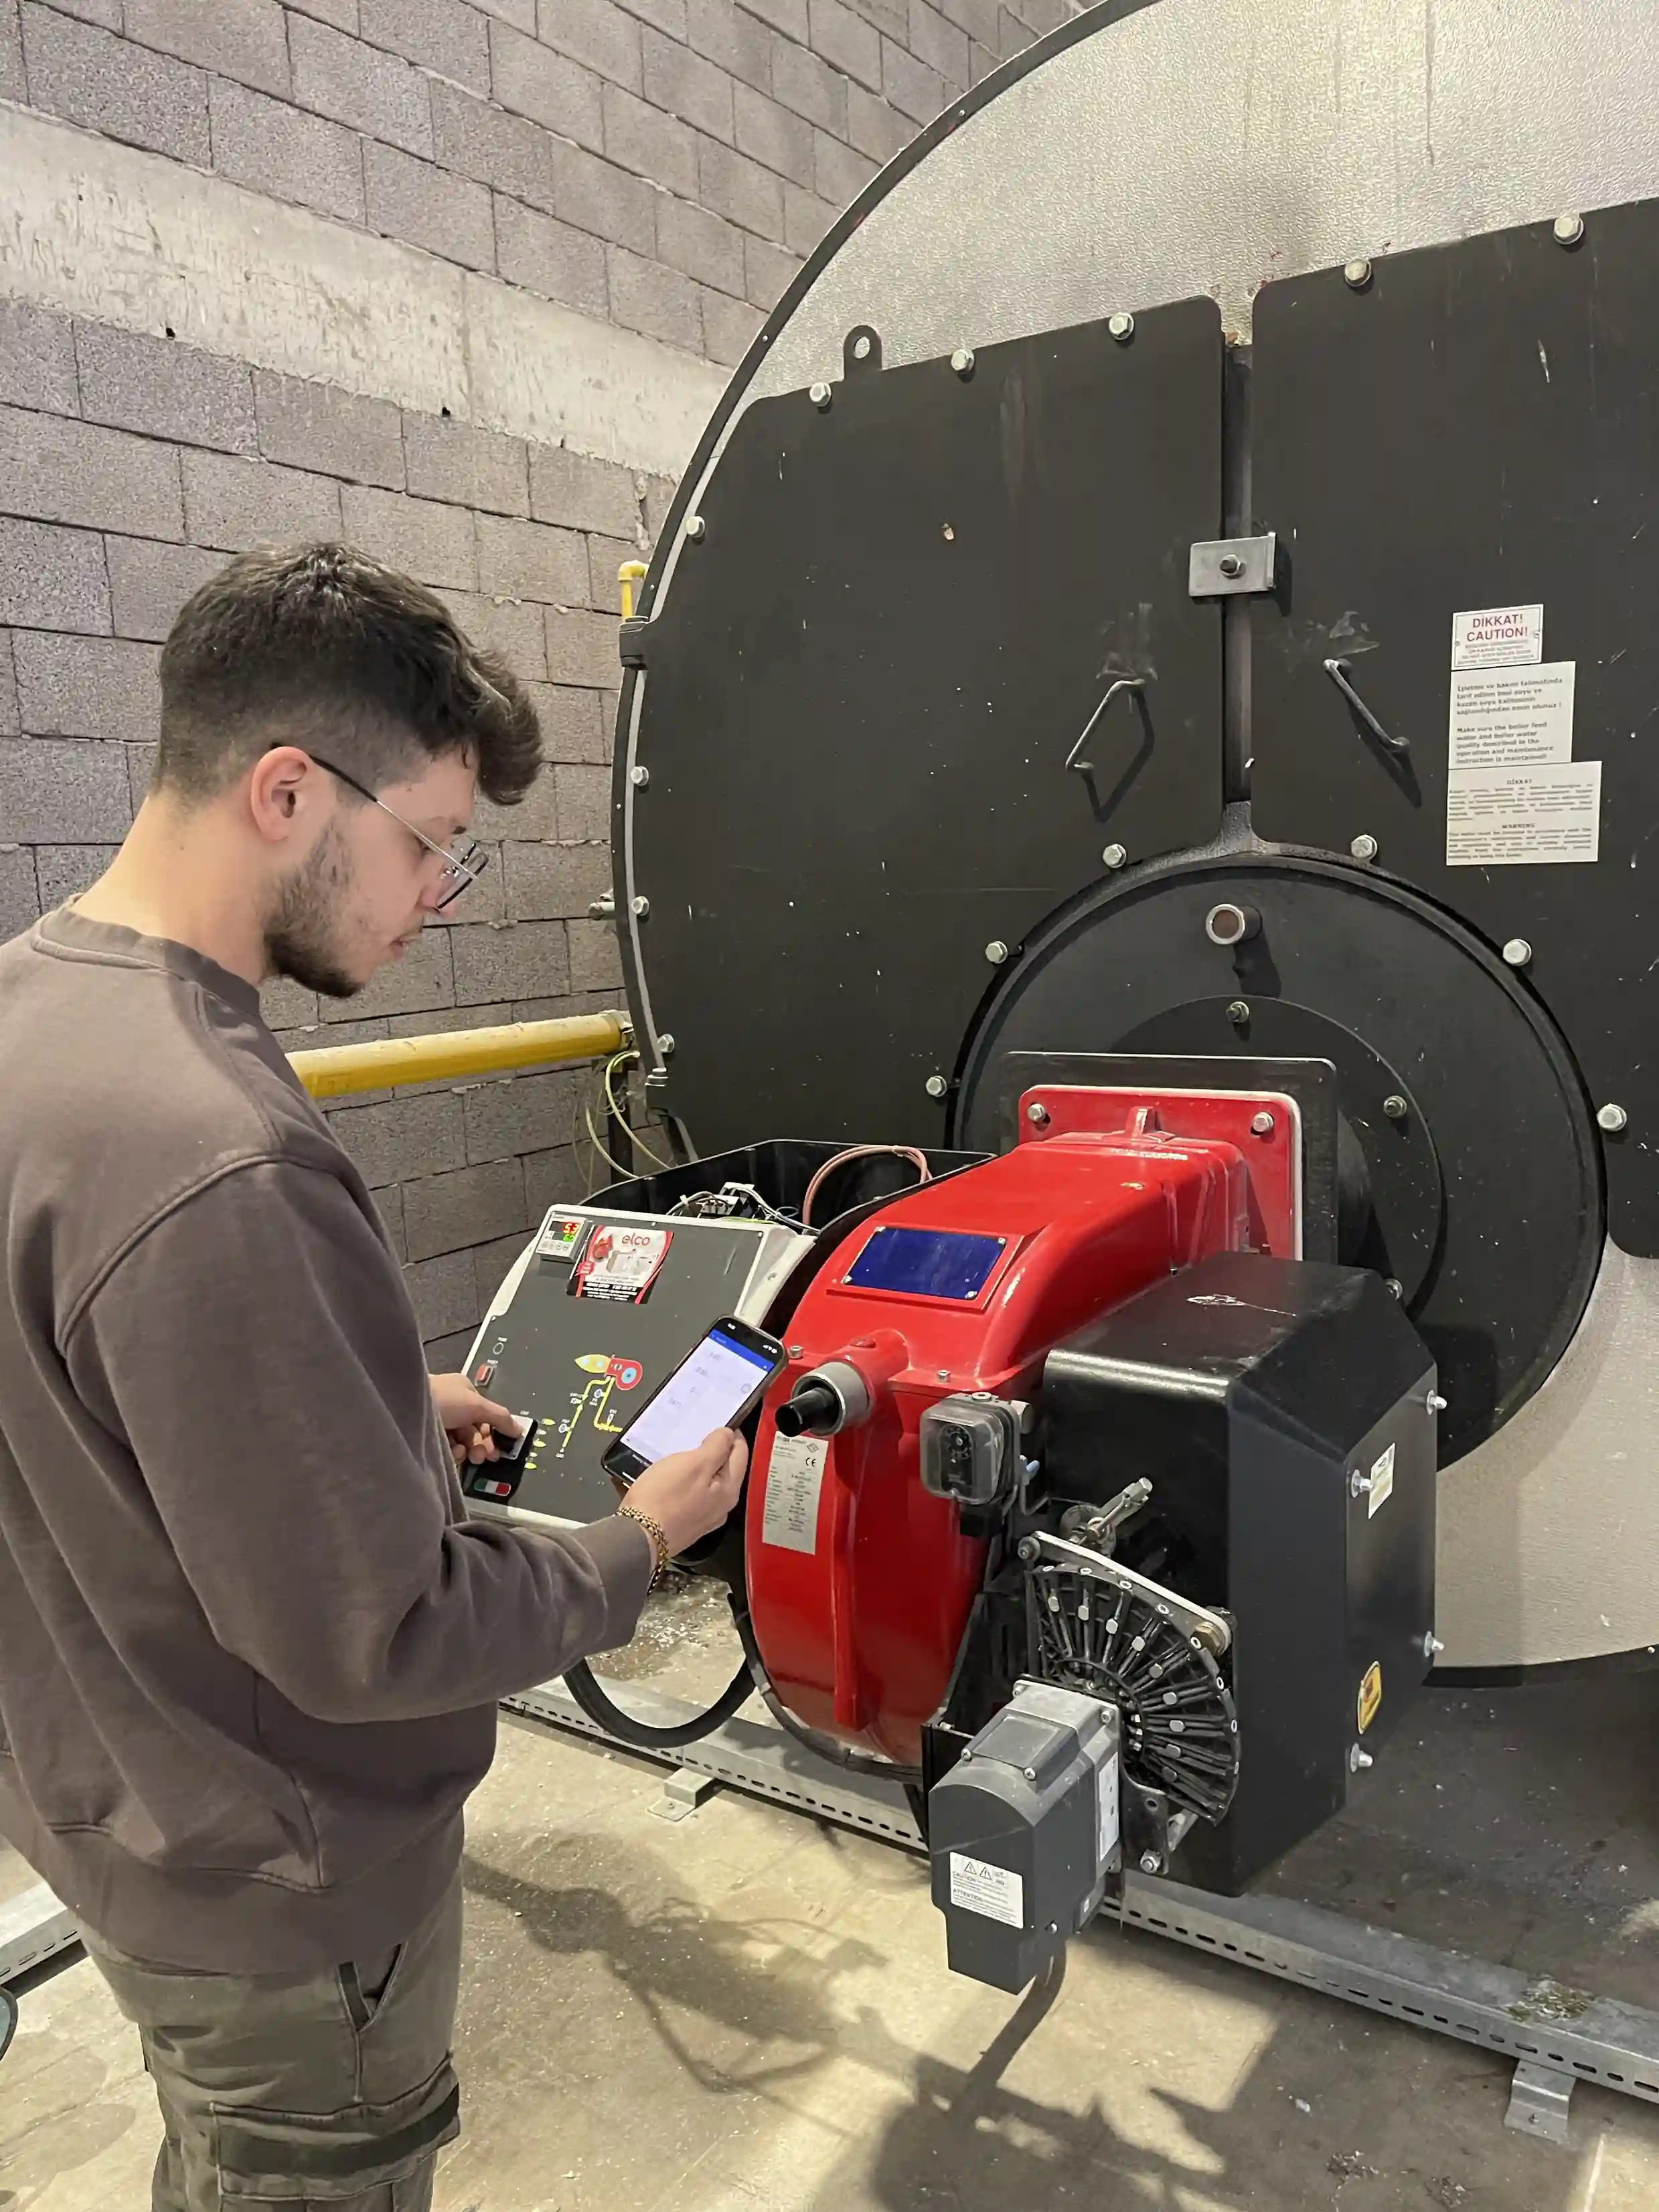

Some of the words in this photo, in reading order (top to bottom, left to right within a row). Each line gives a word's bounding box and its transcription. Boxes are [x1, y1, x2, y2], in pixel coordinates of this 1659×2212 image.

[1472, 613, 1523, 628] DİKKAT!
[1467, 627, 1527, 641] CAUTION!
[563, 1222, 580, 1235] 53
[622, 1232, 650, 1246] elco
